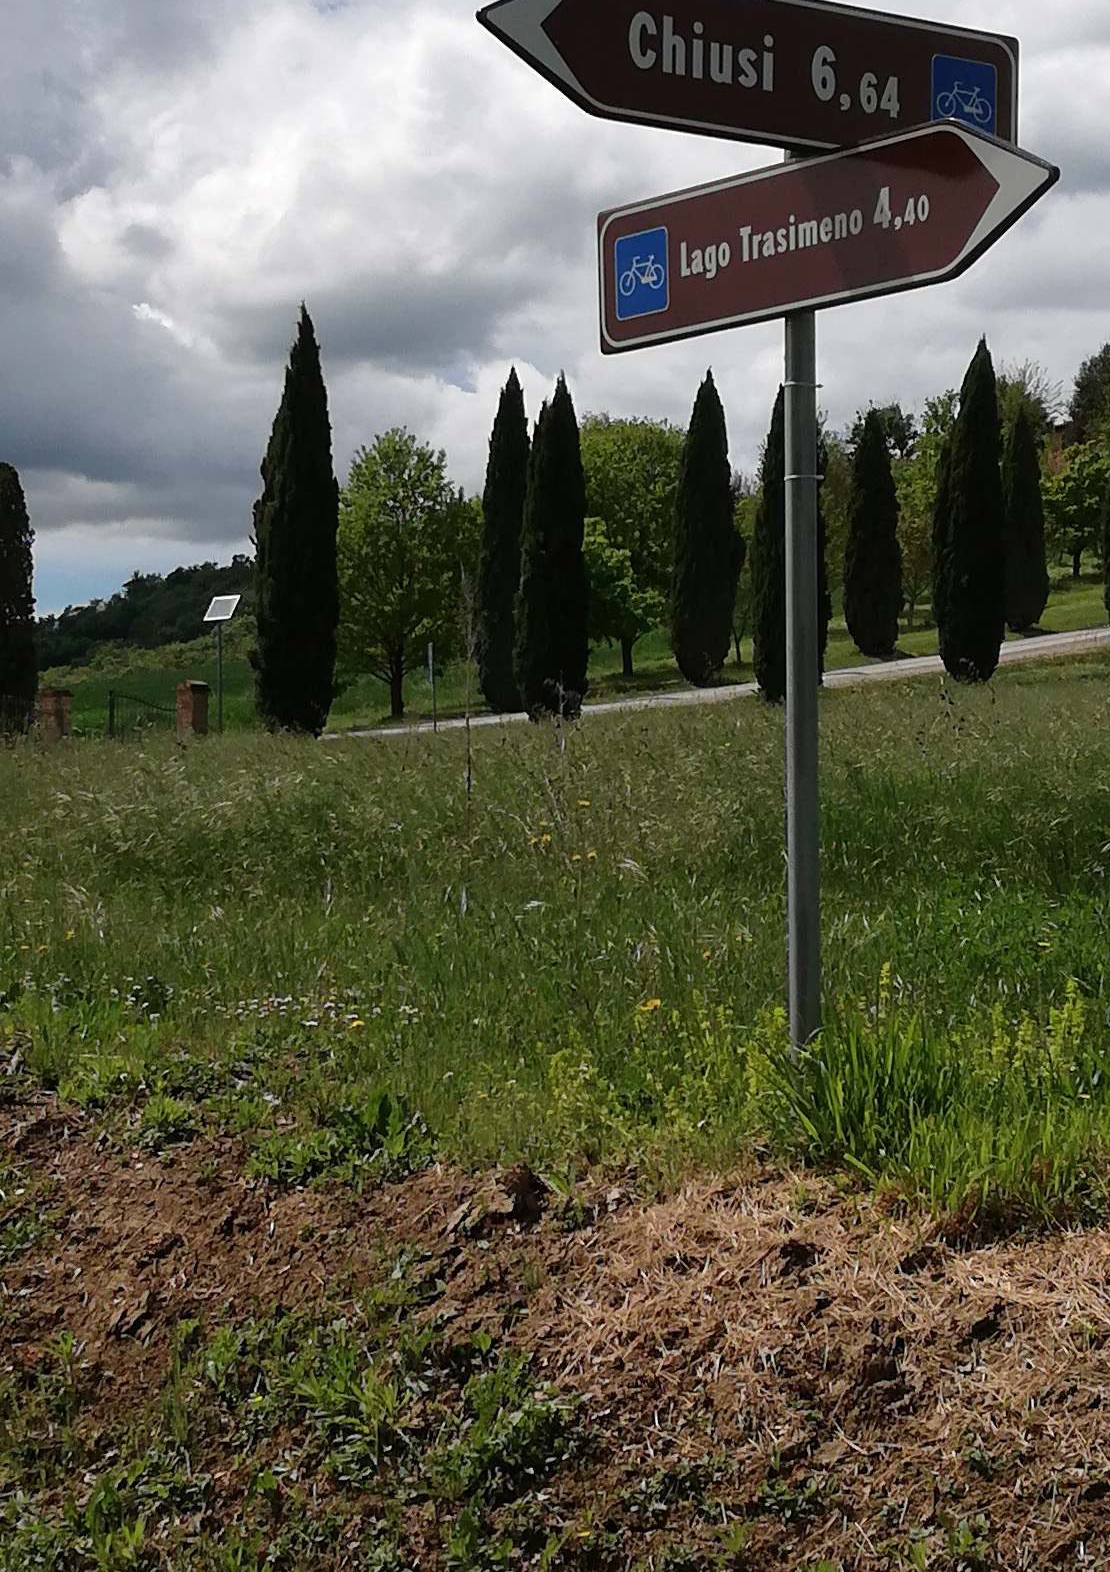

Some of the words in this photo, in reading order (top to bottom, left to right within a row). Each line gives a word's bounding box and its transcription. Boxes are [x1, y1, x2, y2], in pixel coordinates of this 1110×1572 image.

[628, 10, 775, 92] Chiusi
[811, 45, 901, 118] 6,64
[680, 241, 731, 280] Lago
[739, 208, 863, 263] Trasimeno
[873, 186, 930, 230] 4,40
